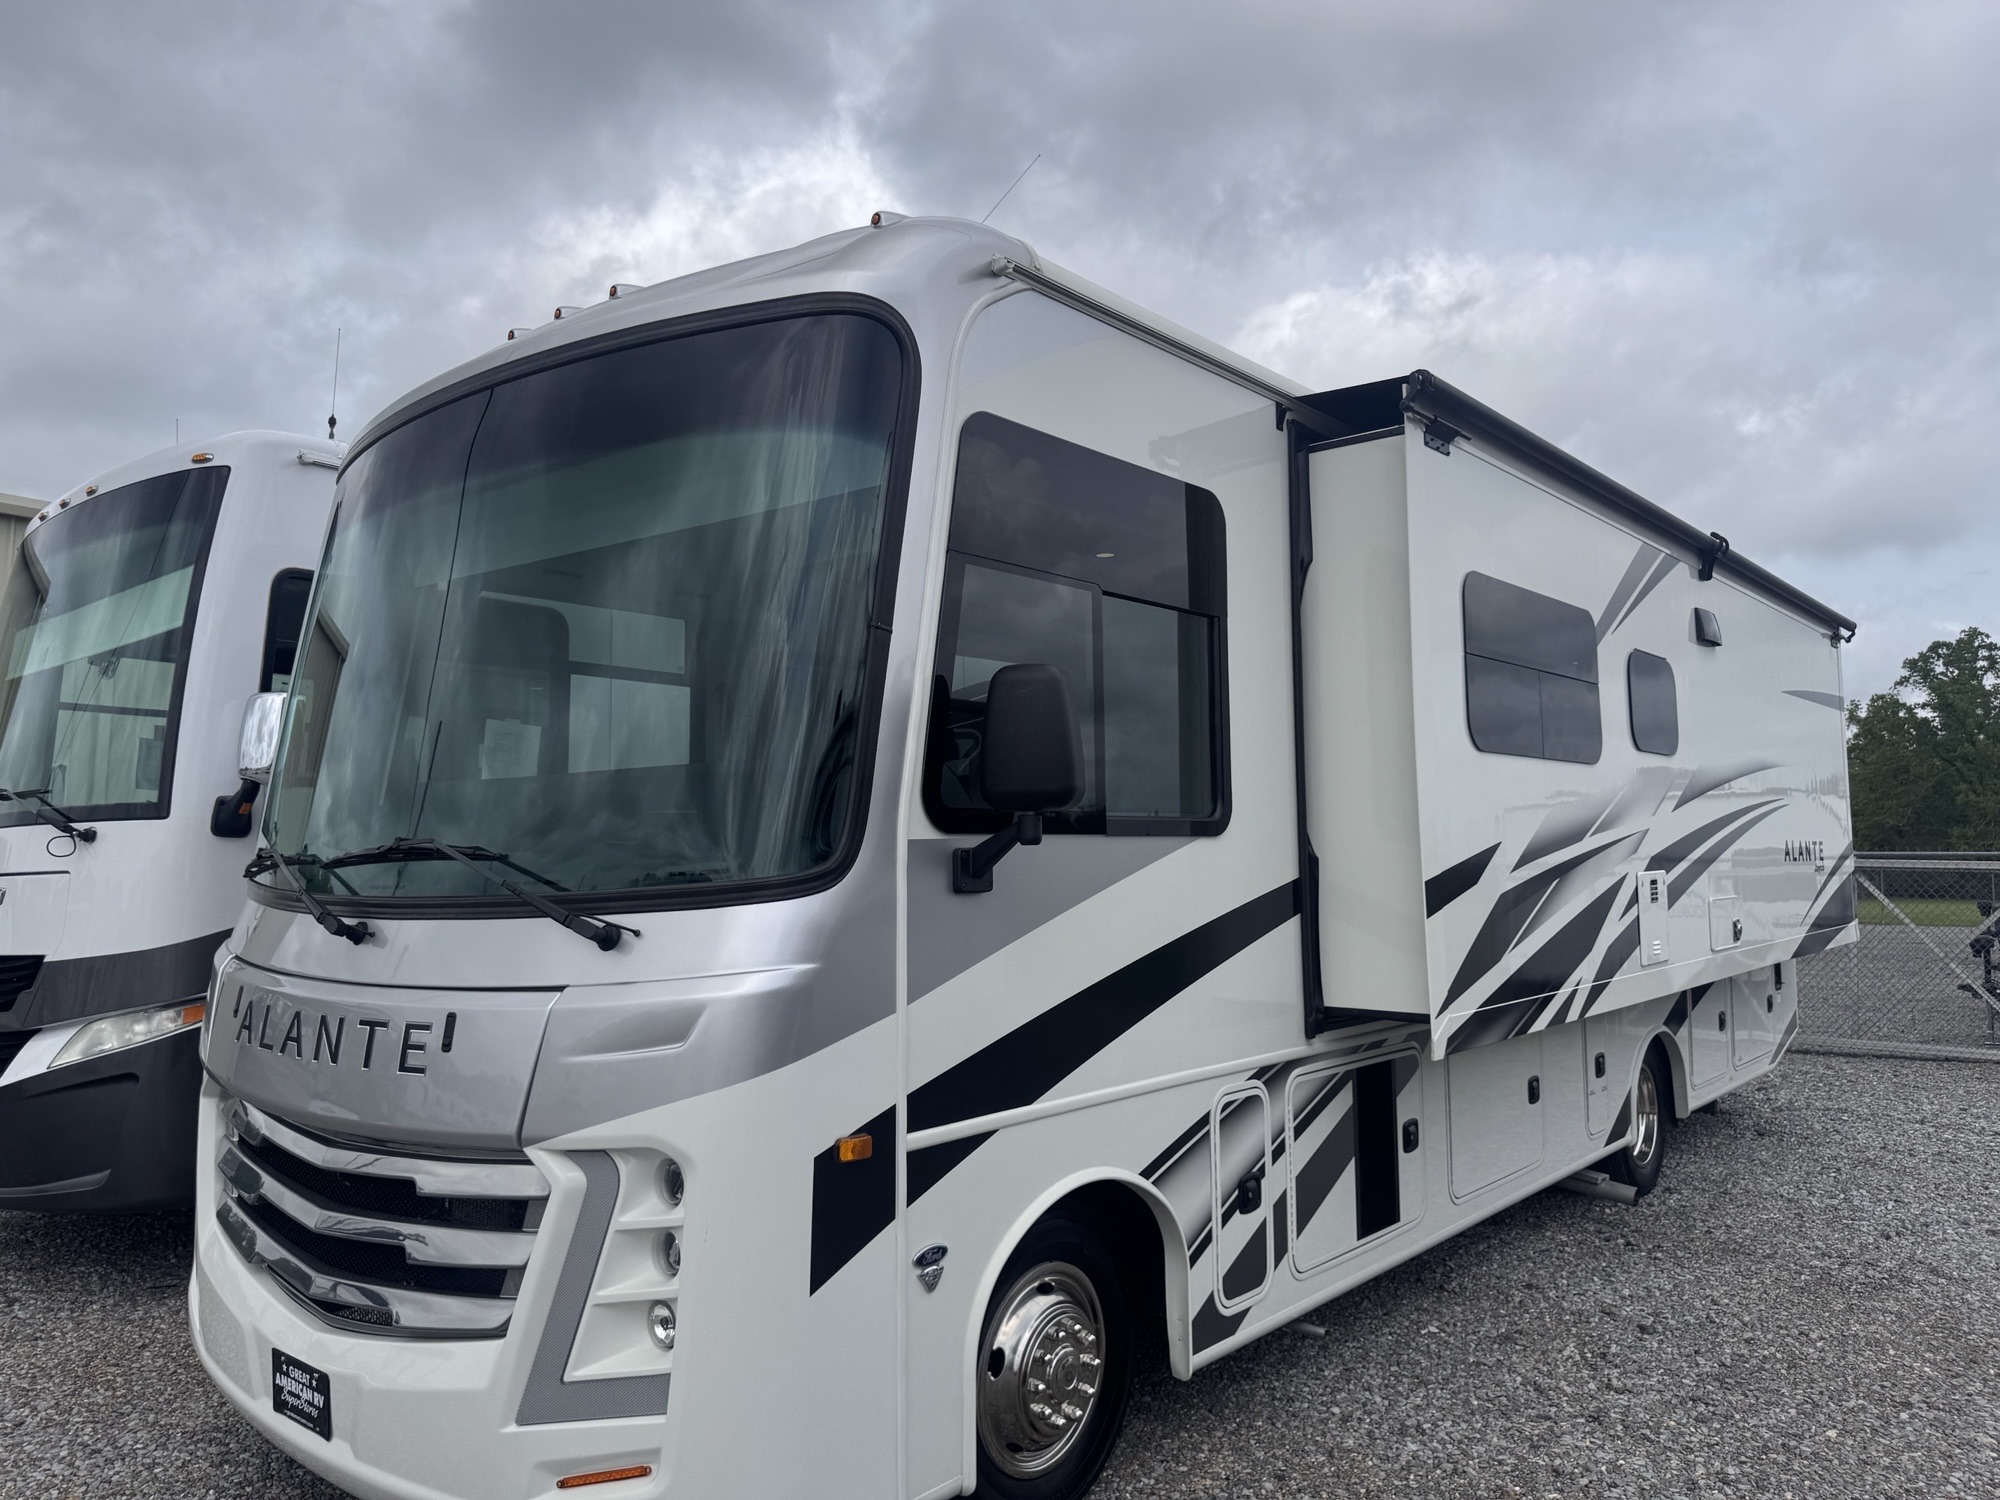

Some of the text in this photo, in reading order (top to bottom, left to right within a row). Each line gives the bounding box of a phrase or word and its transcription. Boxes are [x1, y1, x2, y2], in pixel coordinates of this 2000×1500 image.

[1784, 840, 1824, 862] ALANTE
[234, 1000, 433, 1077] ALANTE
[922, 1248, 943, 1265] Ford
[289, 1366, 310, 1386] GREAT
[275, 1372, 324, 1409] AMERICAN RV
